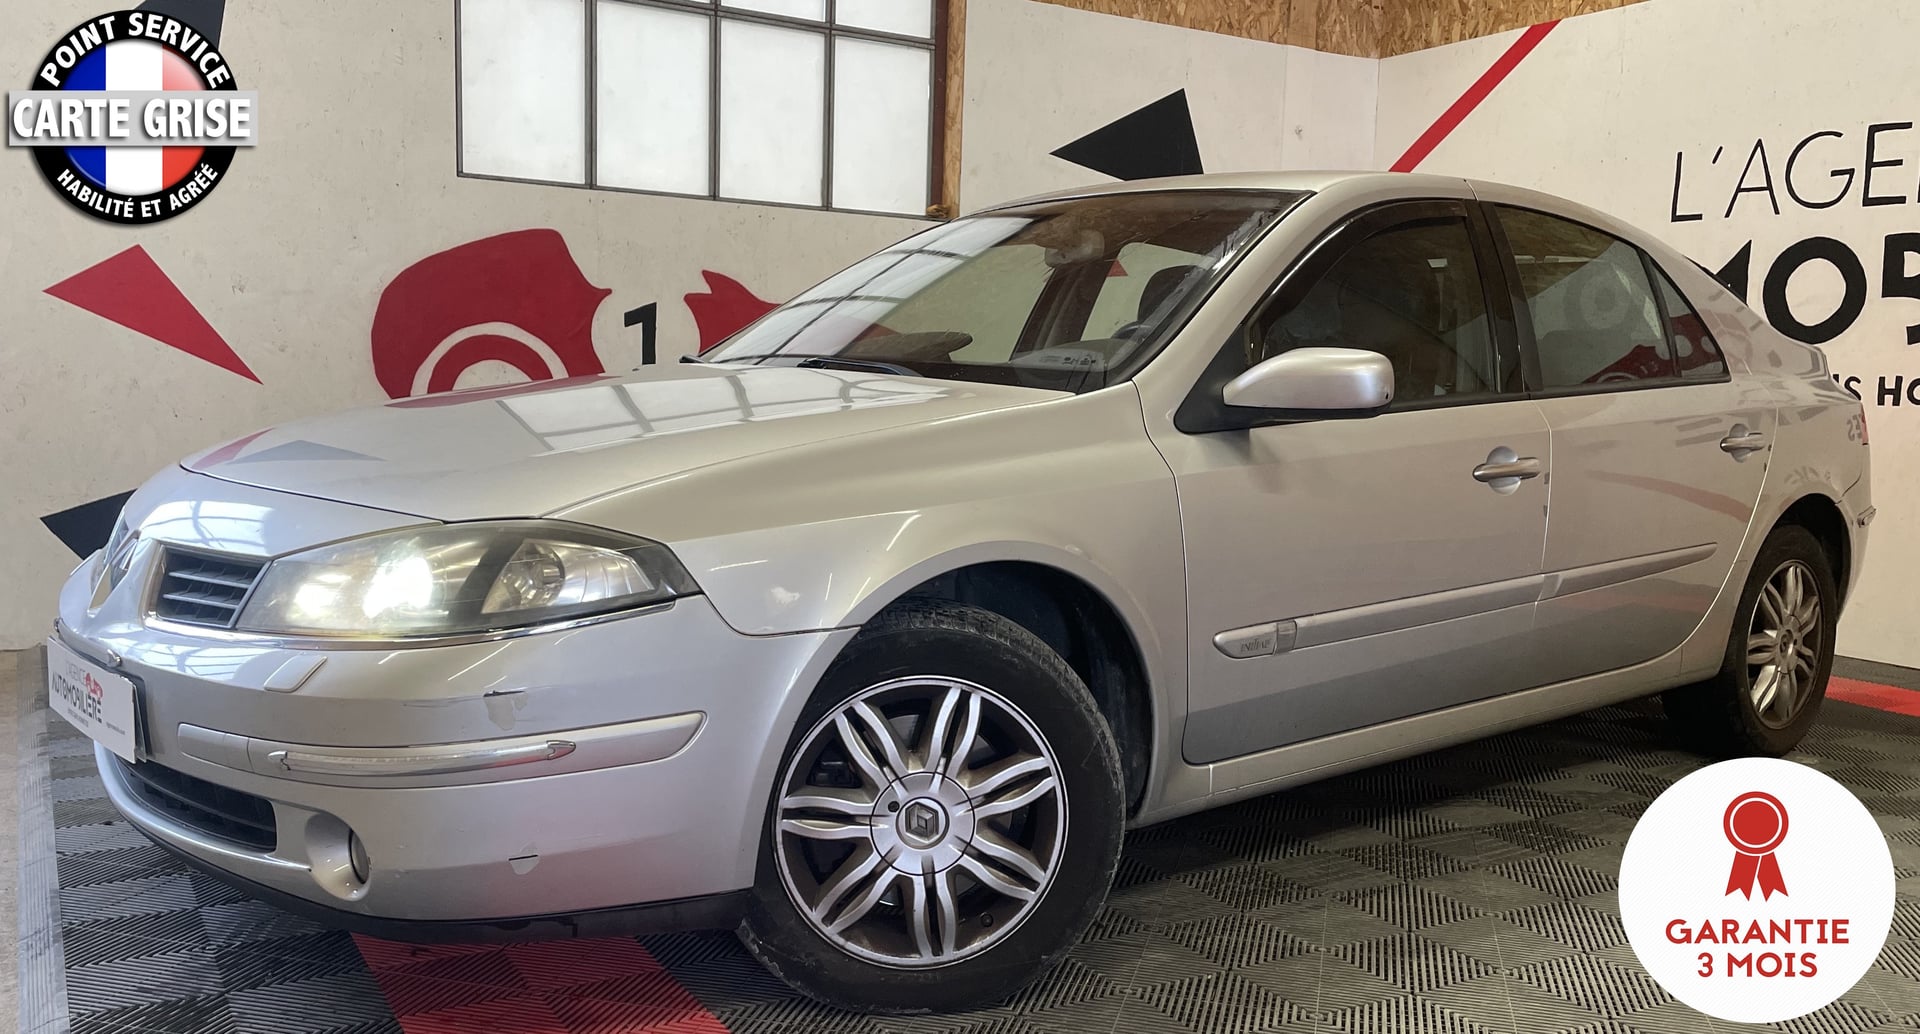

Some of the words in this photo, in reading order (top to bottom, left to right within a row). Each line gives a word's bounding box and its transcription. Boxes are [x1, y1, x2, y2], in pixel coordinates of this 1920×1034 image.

[1671, 121, 1920, 223] L'AGE
[623, 302, 657, 366] 1
[1832, 373, 1862, 401] S
